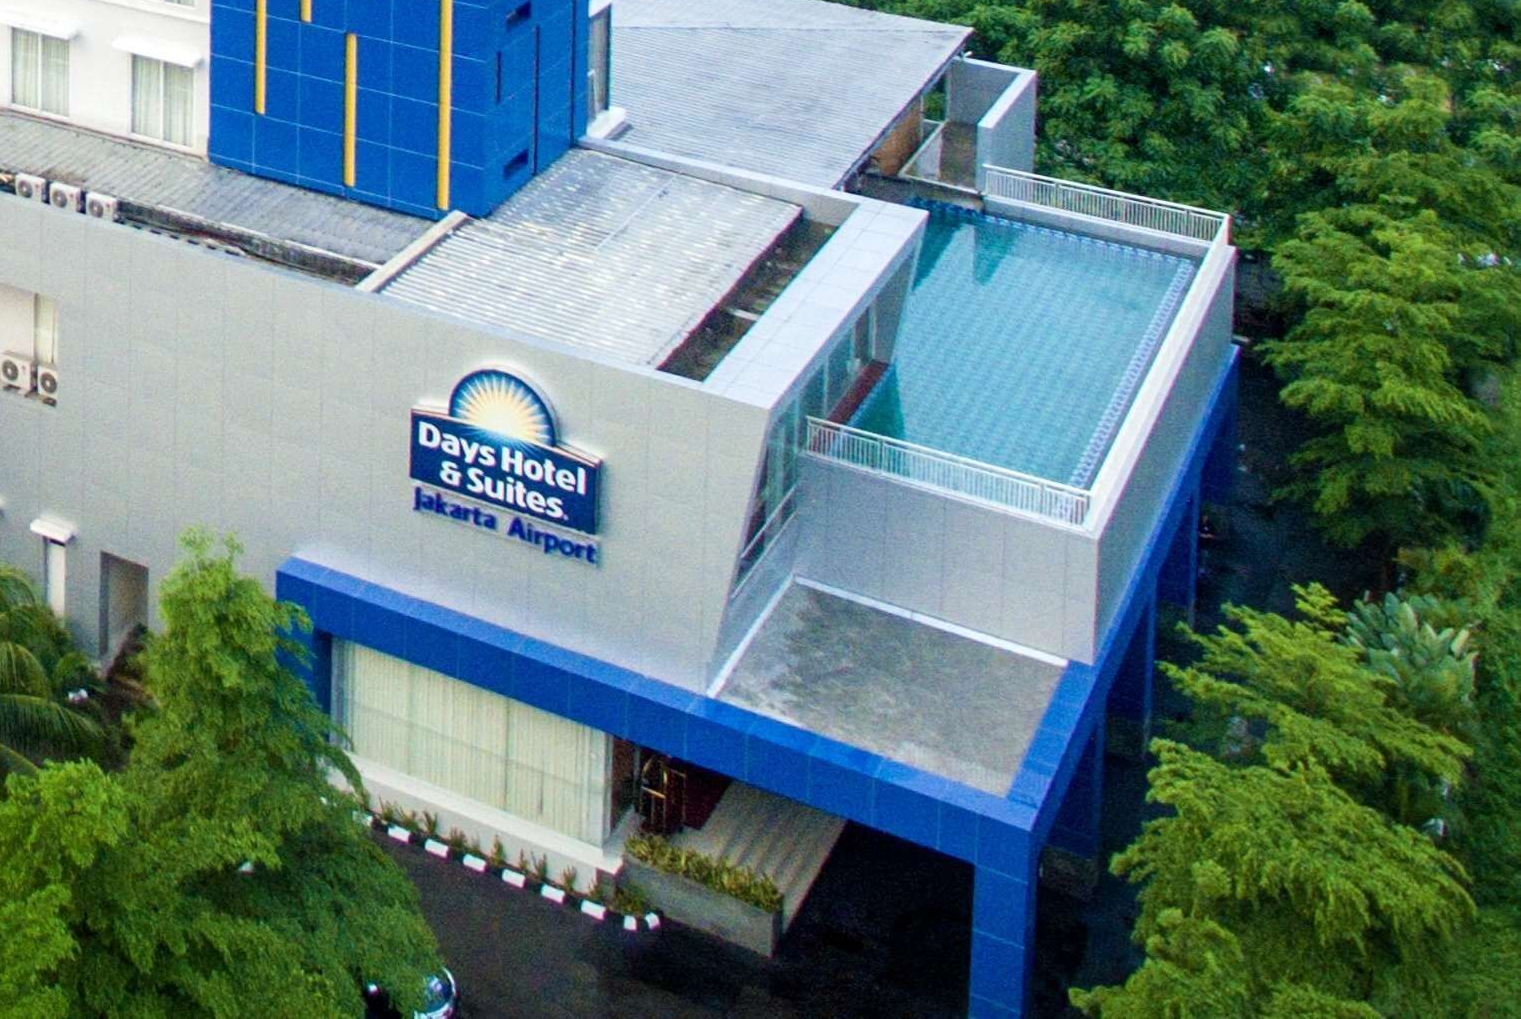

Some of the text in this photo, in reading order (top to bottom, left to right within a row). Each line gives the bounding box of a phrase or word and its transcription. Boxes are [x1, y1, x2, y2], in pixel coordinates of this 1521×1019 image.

[418, 420, 587, 496] Days Hotel
[439, 460, 564, 519] & Suites
[413, 486, 597, 564] Jakarta Airport
